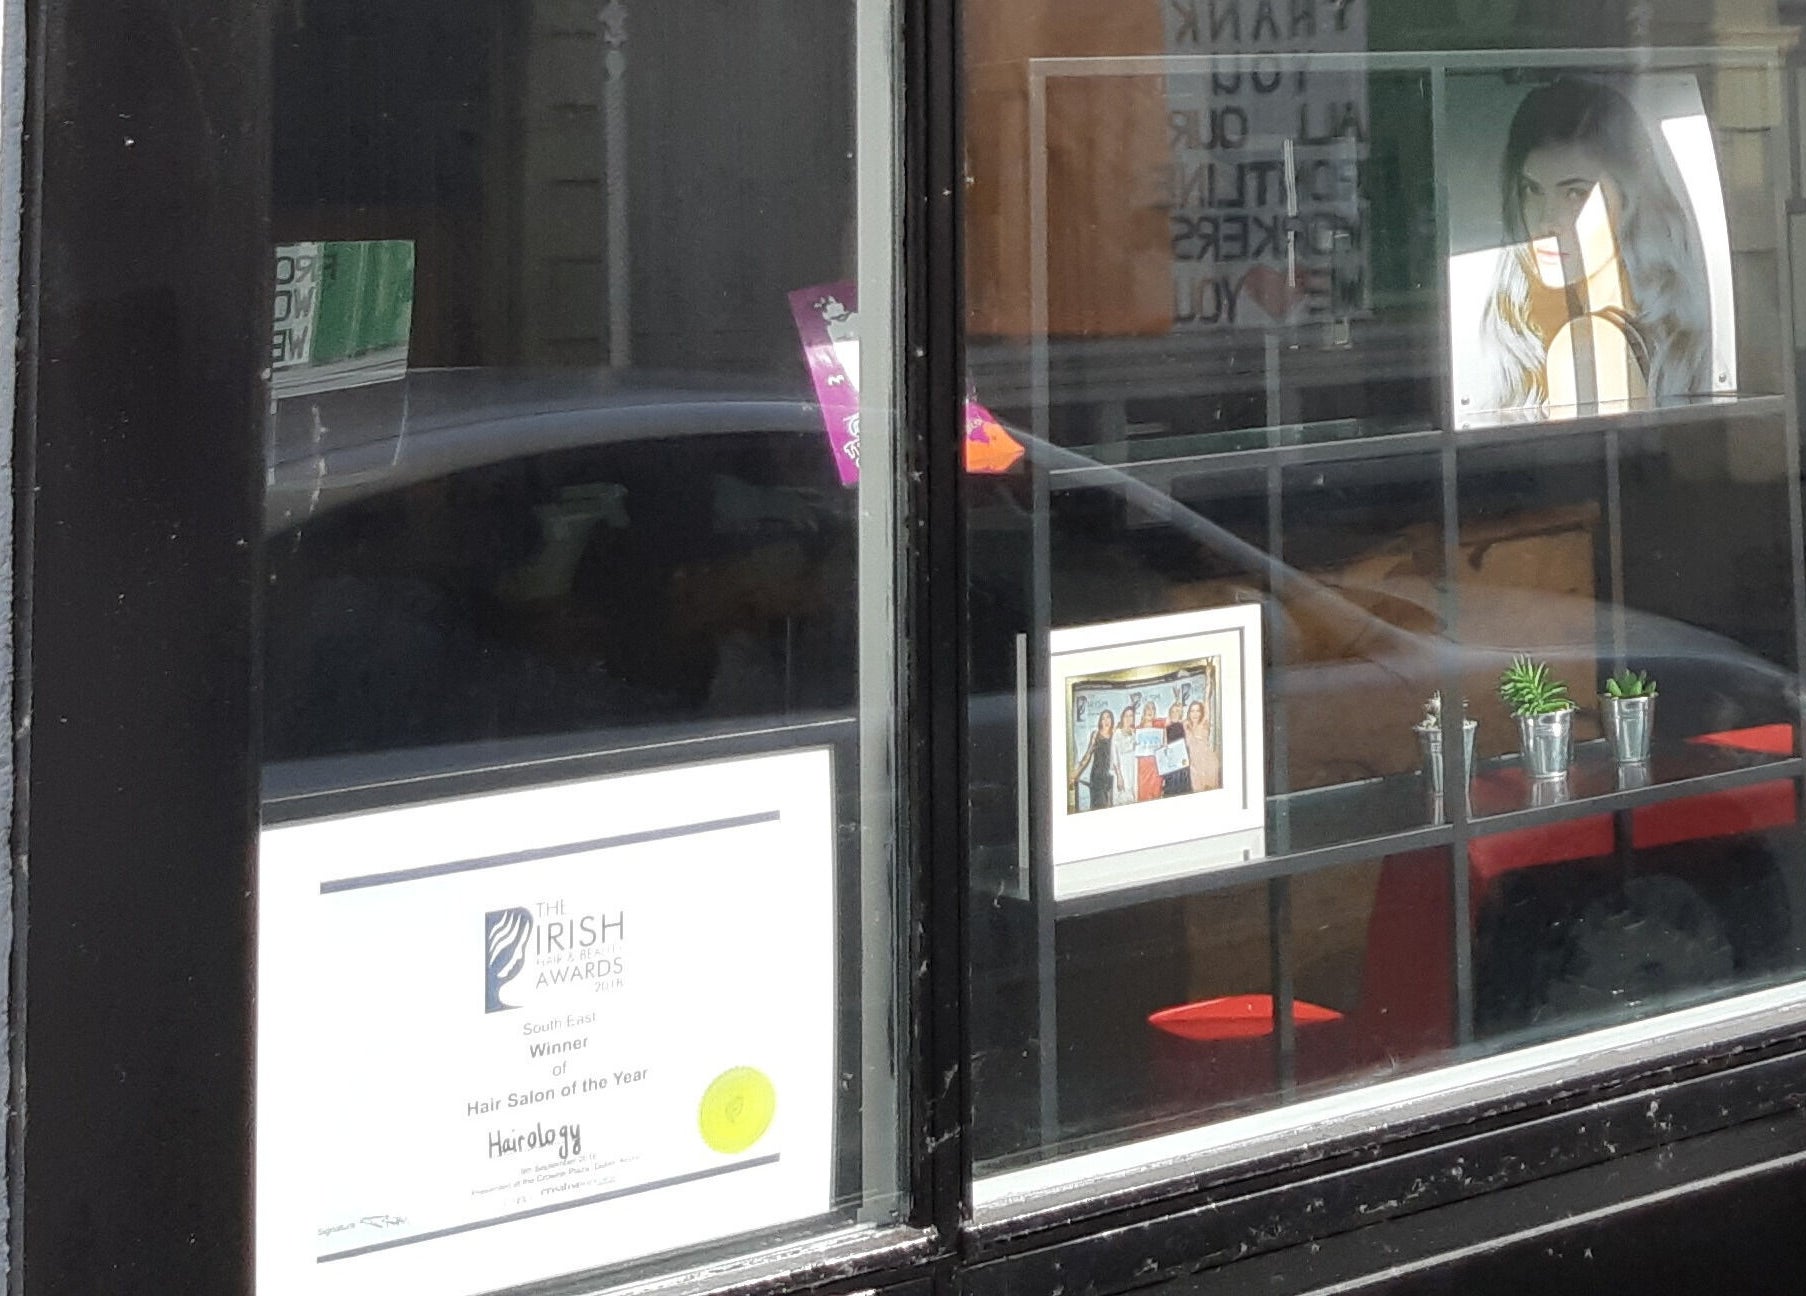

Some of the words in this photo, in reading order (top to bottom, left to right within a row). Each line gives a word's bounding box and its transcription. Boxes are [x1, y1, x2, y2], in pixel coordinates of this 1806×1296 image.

[536, 911, 624, 956] IRISH
[535, 957, 624, 989] AWARDS
[522, 1017, 563, 1037] South
[566, 1011, 597, 1029] East
[529, 1035, 589, 1059] Winner
[551, 1060, 568, 1077] of
[466, 1097, 502, 1118] Hair
[507, 1087, 556, 1109] Salon
[560, 1079, 578, 1098] of
[581, 1075, 608, 1094] the
[613, 1067, 649, 1087] Year
[487, 1121, 582, 1160] Hairology
